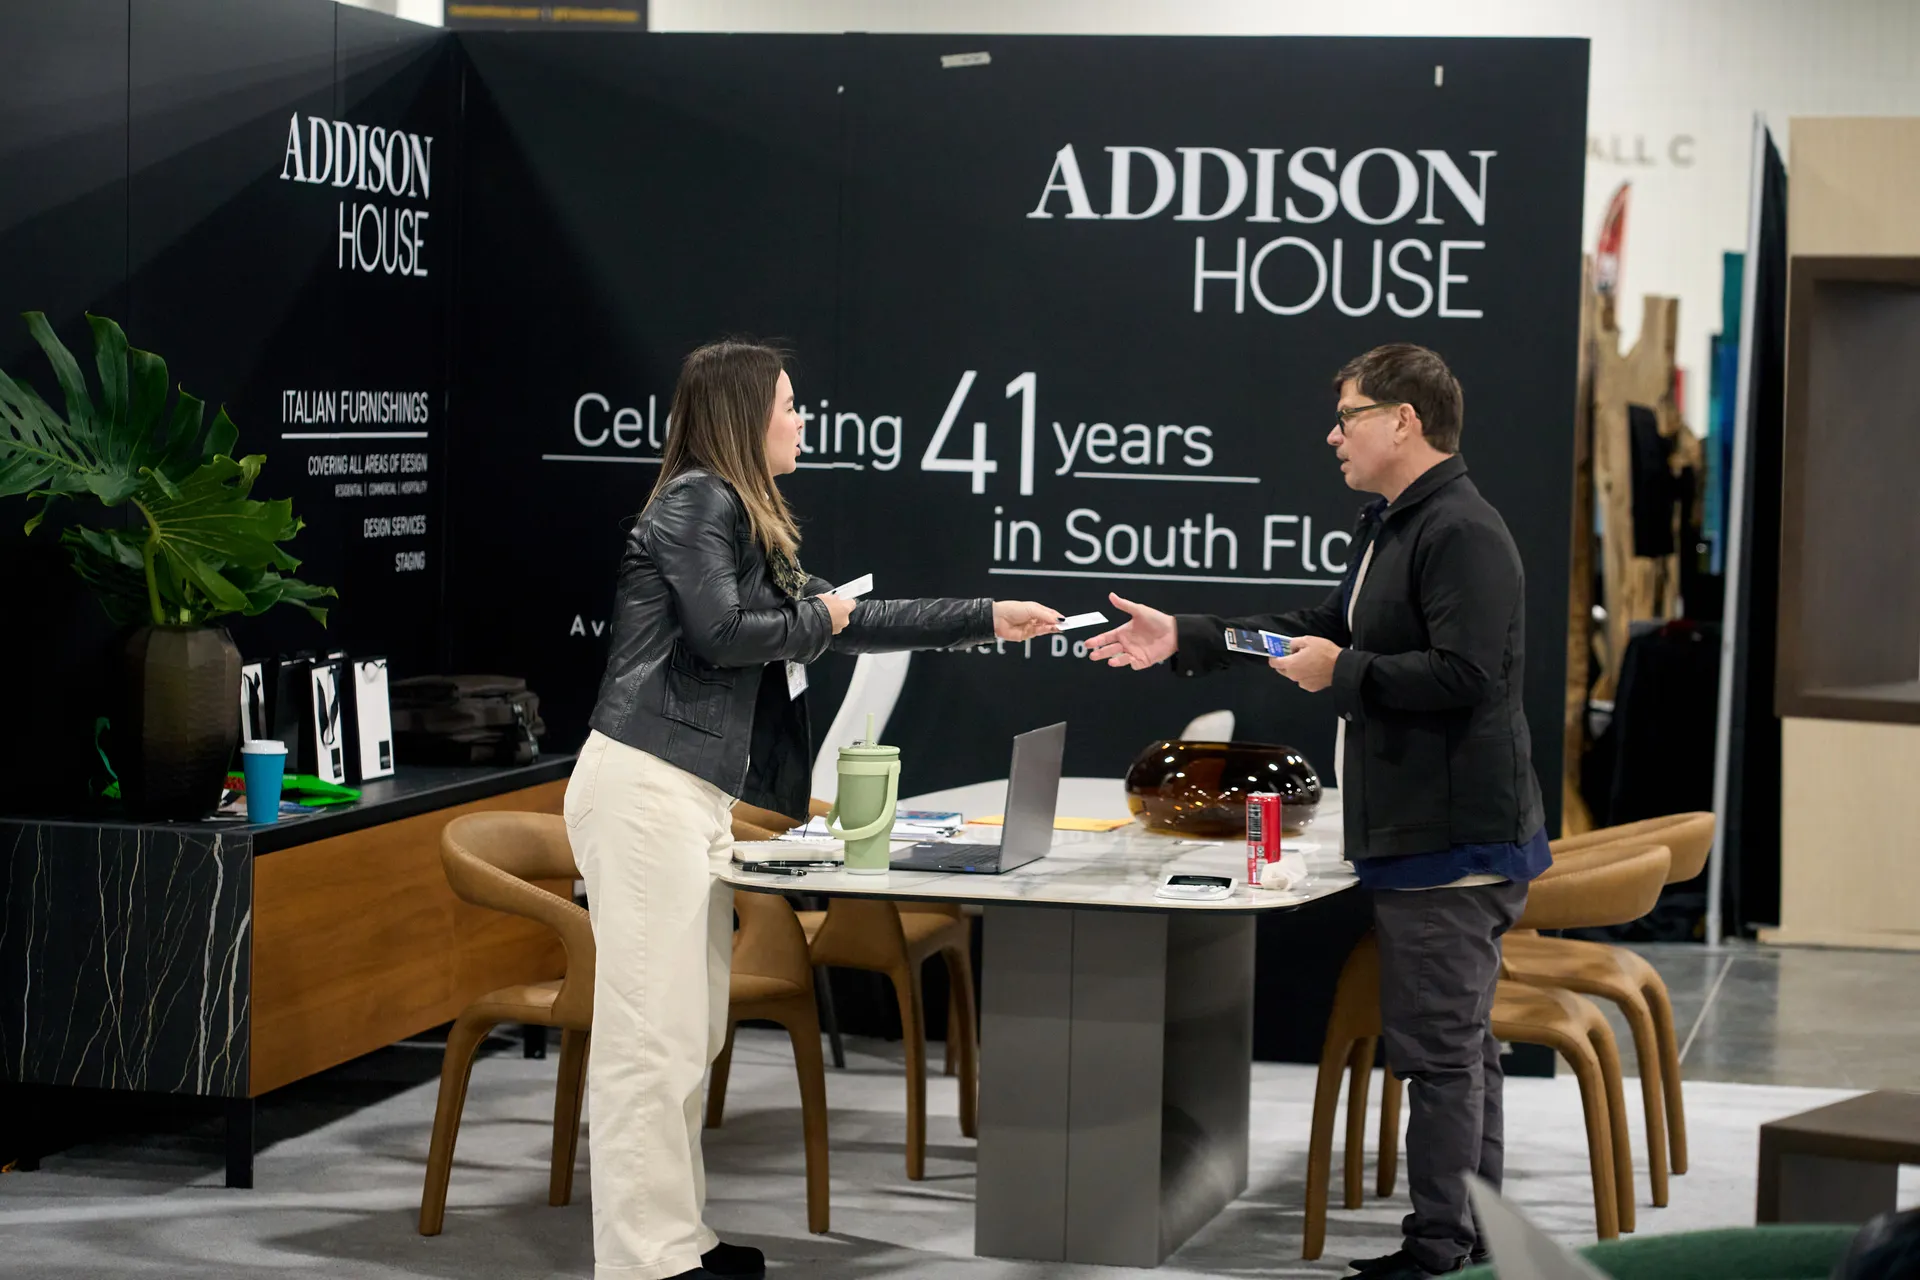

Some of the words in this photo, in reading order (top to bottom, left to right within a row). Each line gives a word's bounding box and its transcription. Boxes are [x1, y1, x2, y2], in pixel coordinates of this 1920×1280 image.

[279, 111, 433, 199] ADDISON
[1026, 143, 1498, 226] ADDISON
[1586, 134, 1657, 167] ALL
[1667, 133, 1697, 169] C
[338, 201, 429, 277] HOUSE
[1194, 236, 1486, 318] HOUSE
[282, 390, 336, 424] ITALIAN
[341, 391, 429, 424] FURNISHINGS
[573, 393, 902, 471] Celting
[921, 370, 1037, 495] 41
[1052, 421, 1214, 476] years
[308, 455, 348, 476] COVERING
[349, 454, 363, 475] ALL
[365, 454, 389, 474] AREAS
[390, 453, 400, 474] OF
[400, 452, 428, 473] DESIGN
[363, 517, 391, 538] DESIGN
[391, 515, 426, 536] SERVICES
[993, 506, 1042, 562] in
[1064, 508, 1238, 570] South
[1263, 514, 1352, 574] Flo
[395, 551, 425, 572] STAGING
